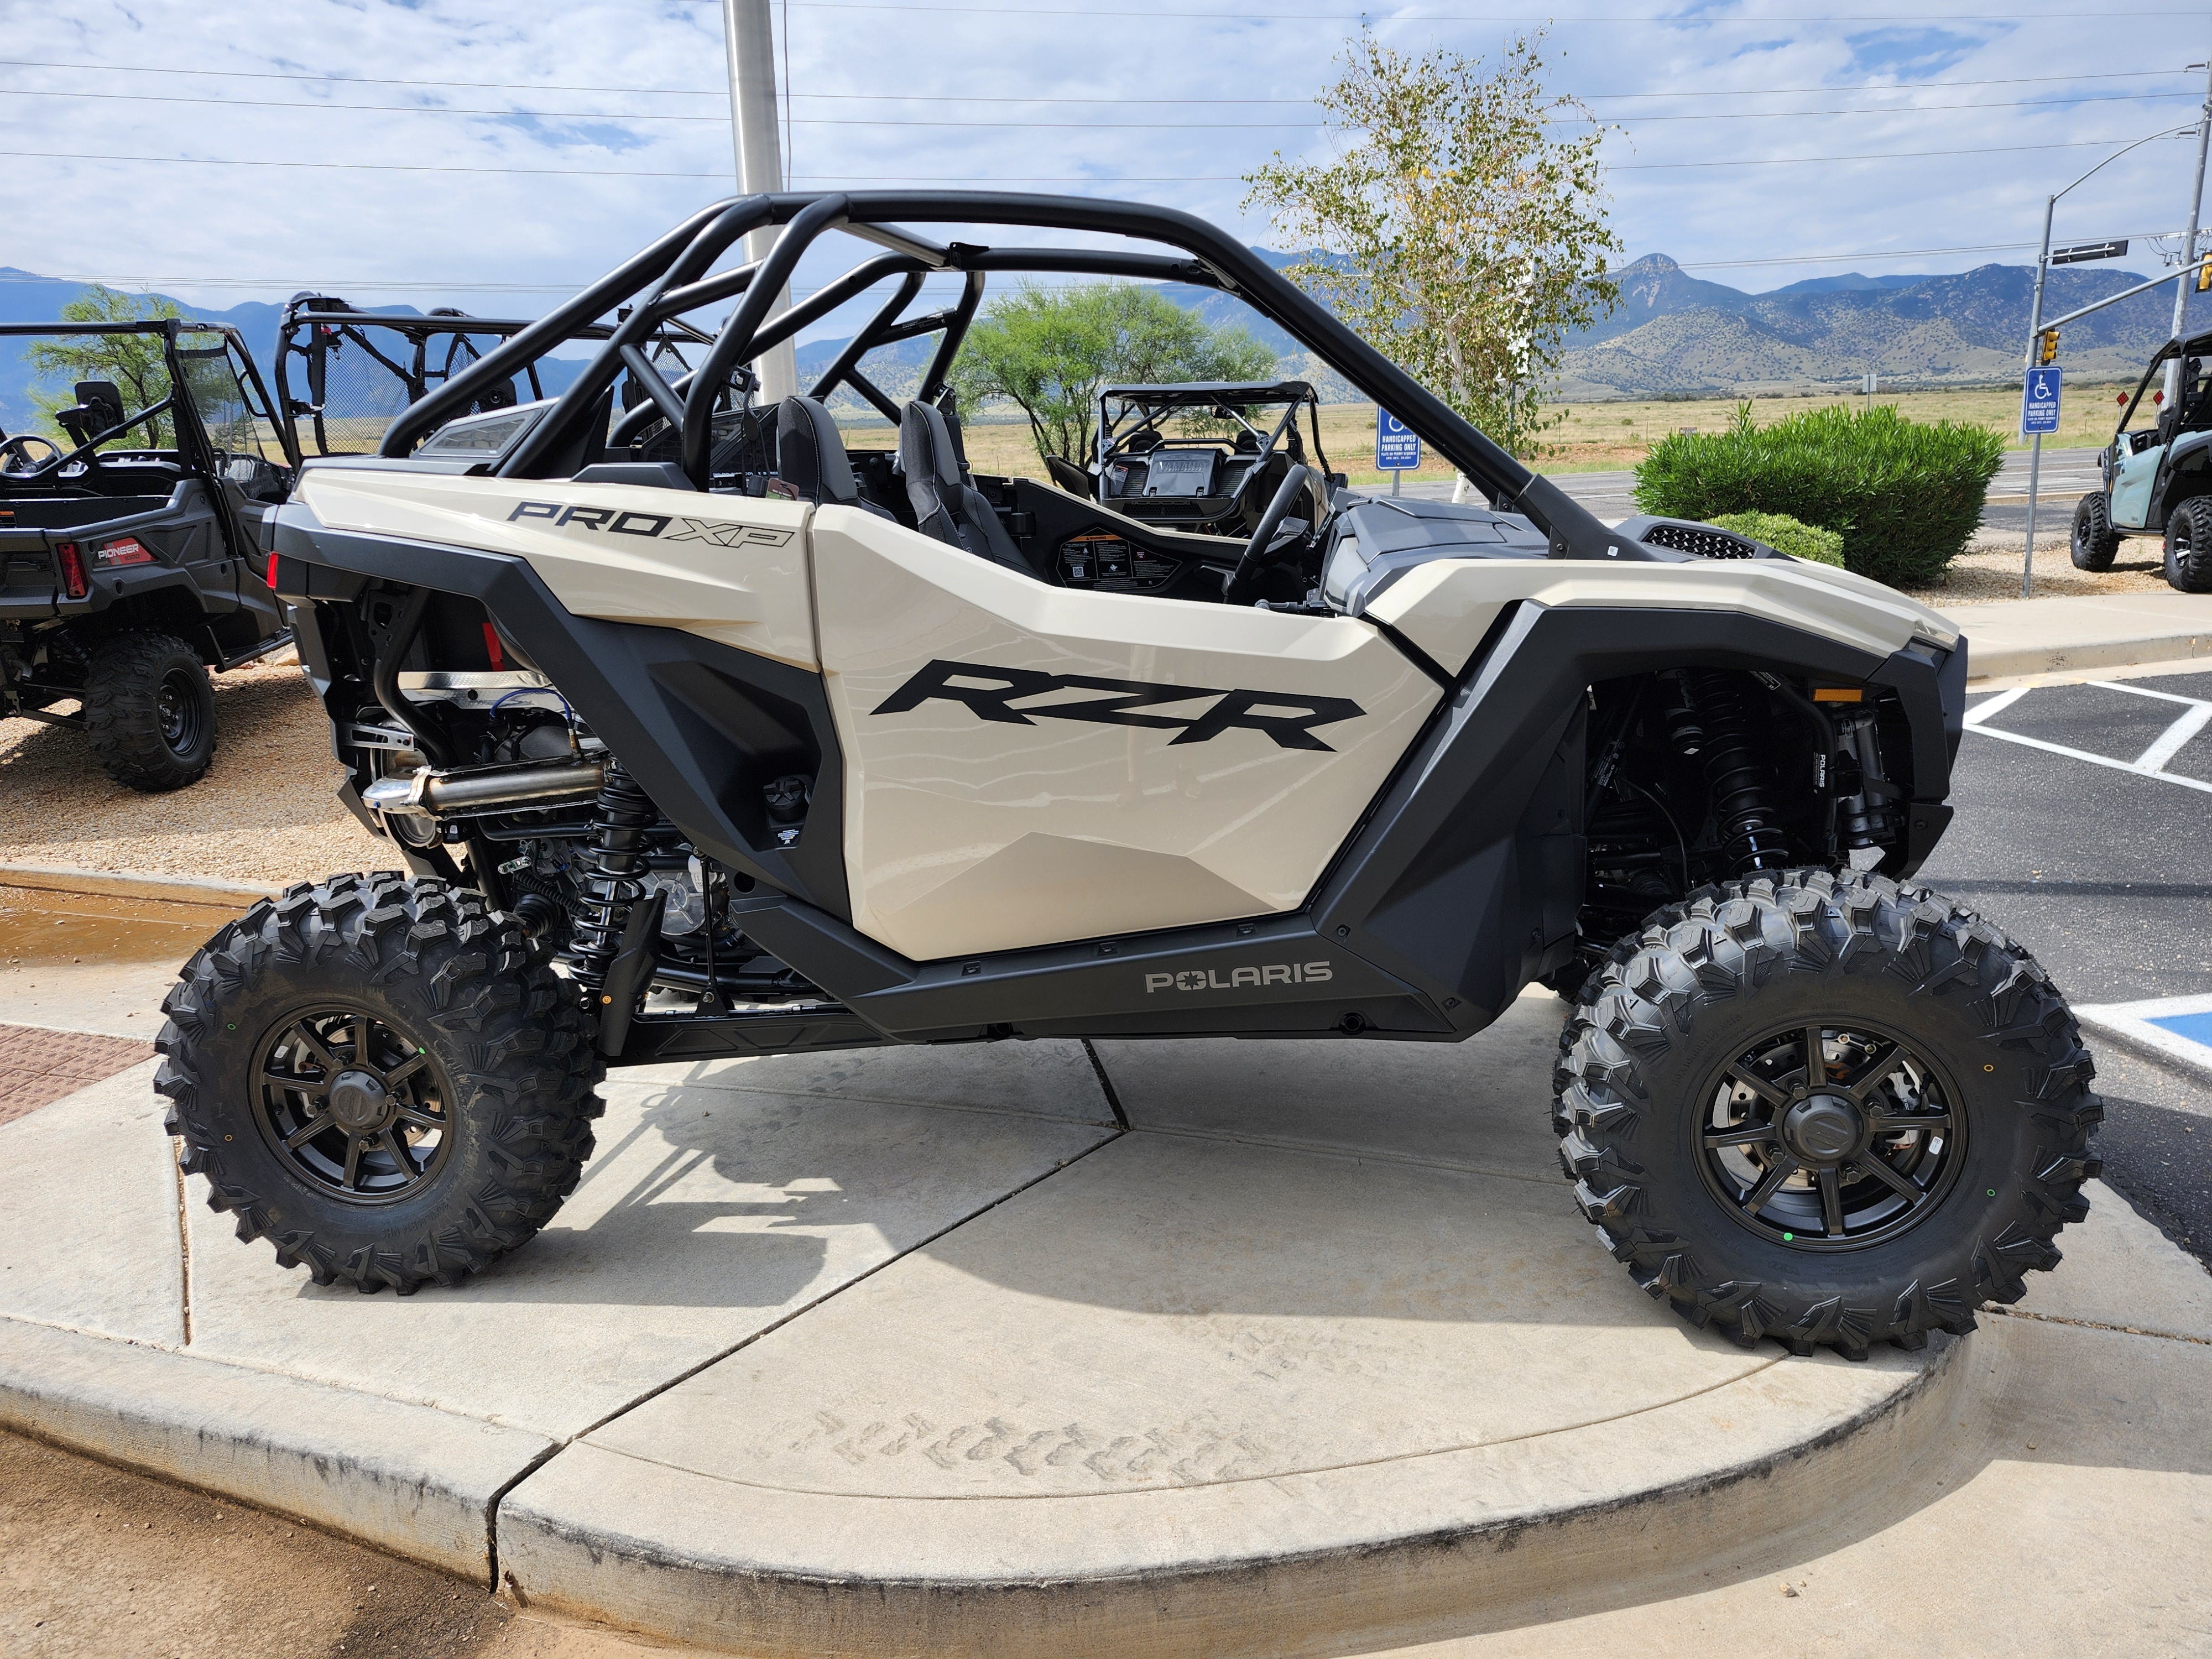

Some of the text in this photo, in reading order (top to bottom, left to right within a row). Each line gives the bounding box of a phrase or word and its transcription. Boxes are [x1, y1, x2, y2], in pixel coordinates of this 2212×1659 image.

[1382, 435, 1416, 443] HANDICAPPED
[1381, 444, 1402, 452] PARKING
[1160, 461, 1203, 472] YAMAHA
[505, 501, 796, 549] PRO XP
[98, 544, 139, 559] PIONEER
[868, 659, 1368, 753] RZR
[1145, 961, 1333, 993] POLARIS
